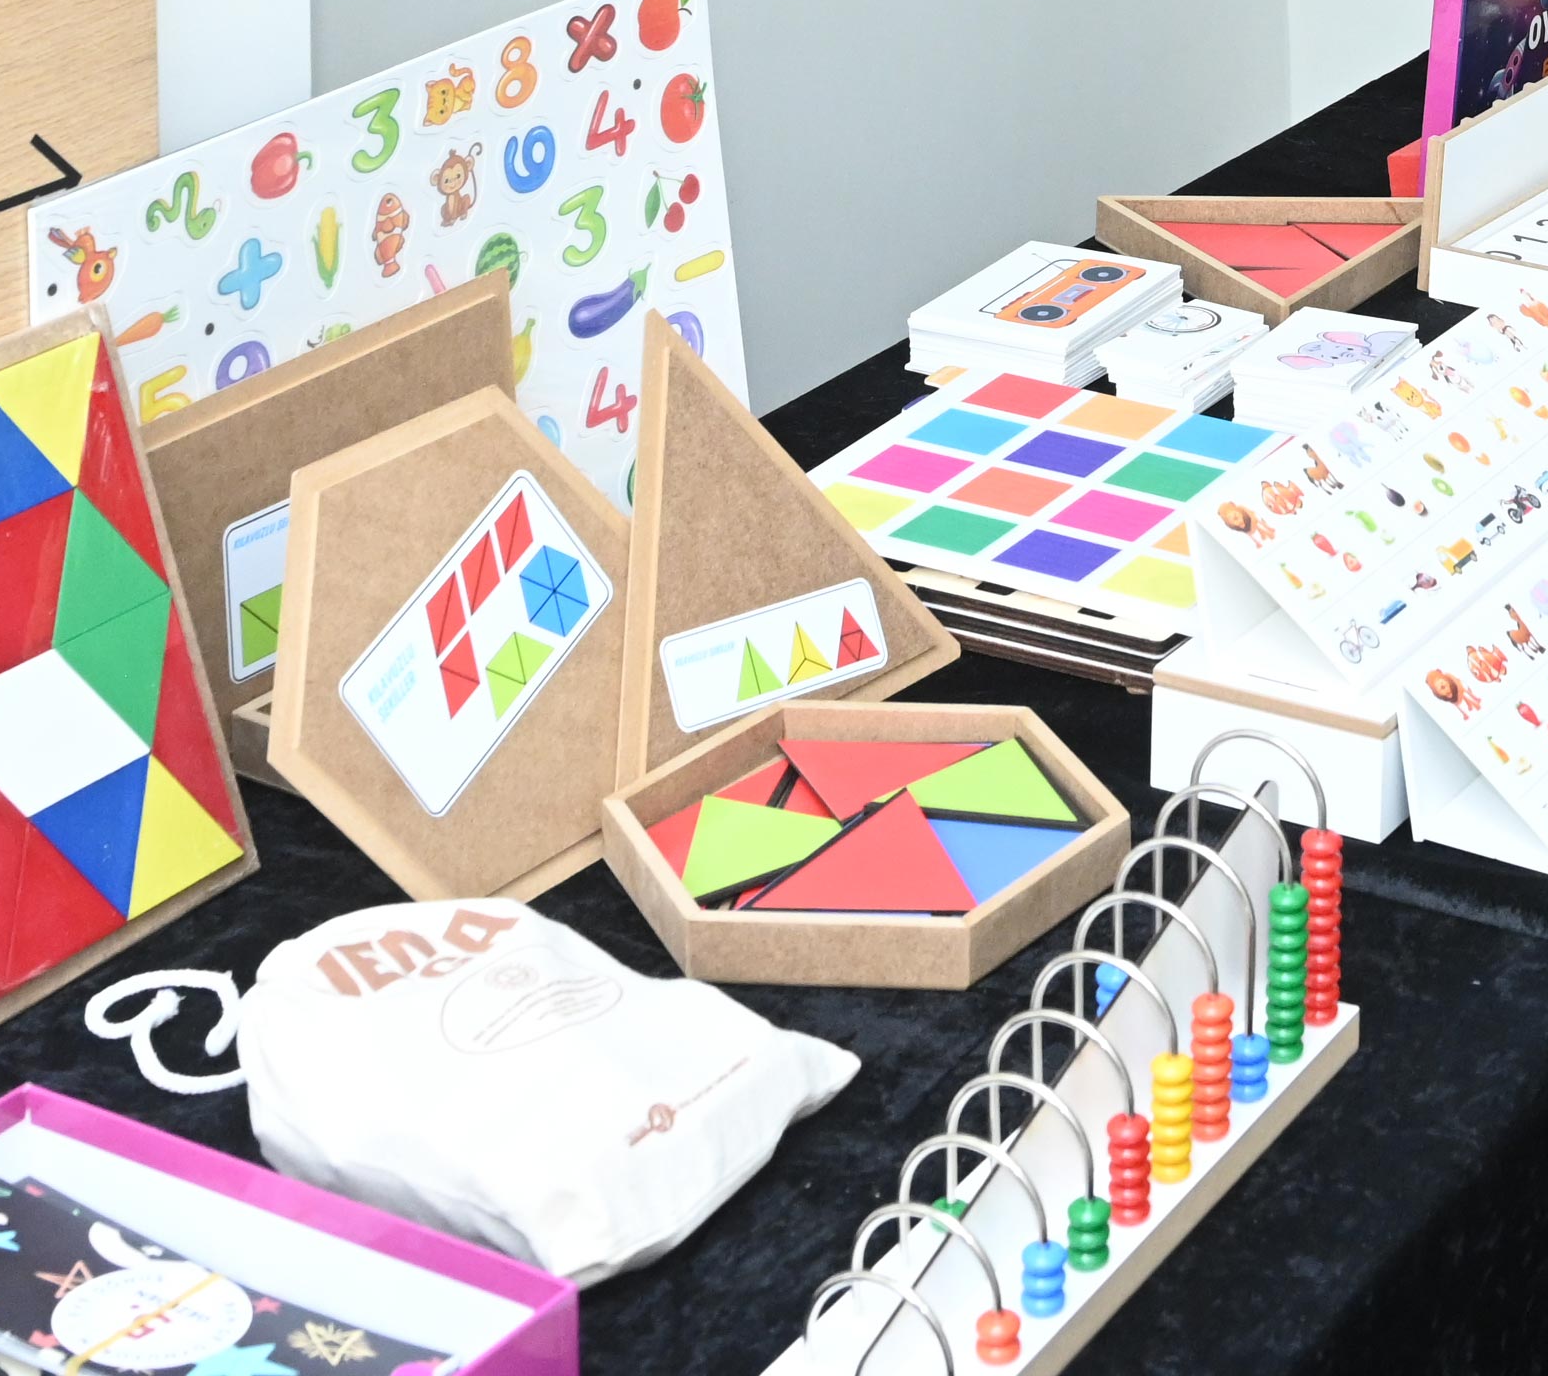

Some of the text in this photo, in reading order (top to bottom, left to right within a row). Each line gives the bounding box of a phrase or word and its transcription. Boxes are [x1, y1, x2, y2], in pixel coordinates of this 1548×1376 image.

[495, 36, 537, 109] 8
[352, 87, 400, 173] 3
[585, 90, 635, 157] 4
[559, 185, 607, 267] 3
[1513, 234, 1548, 244] 1
[585, 366, 638, 434] 4
